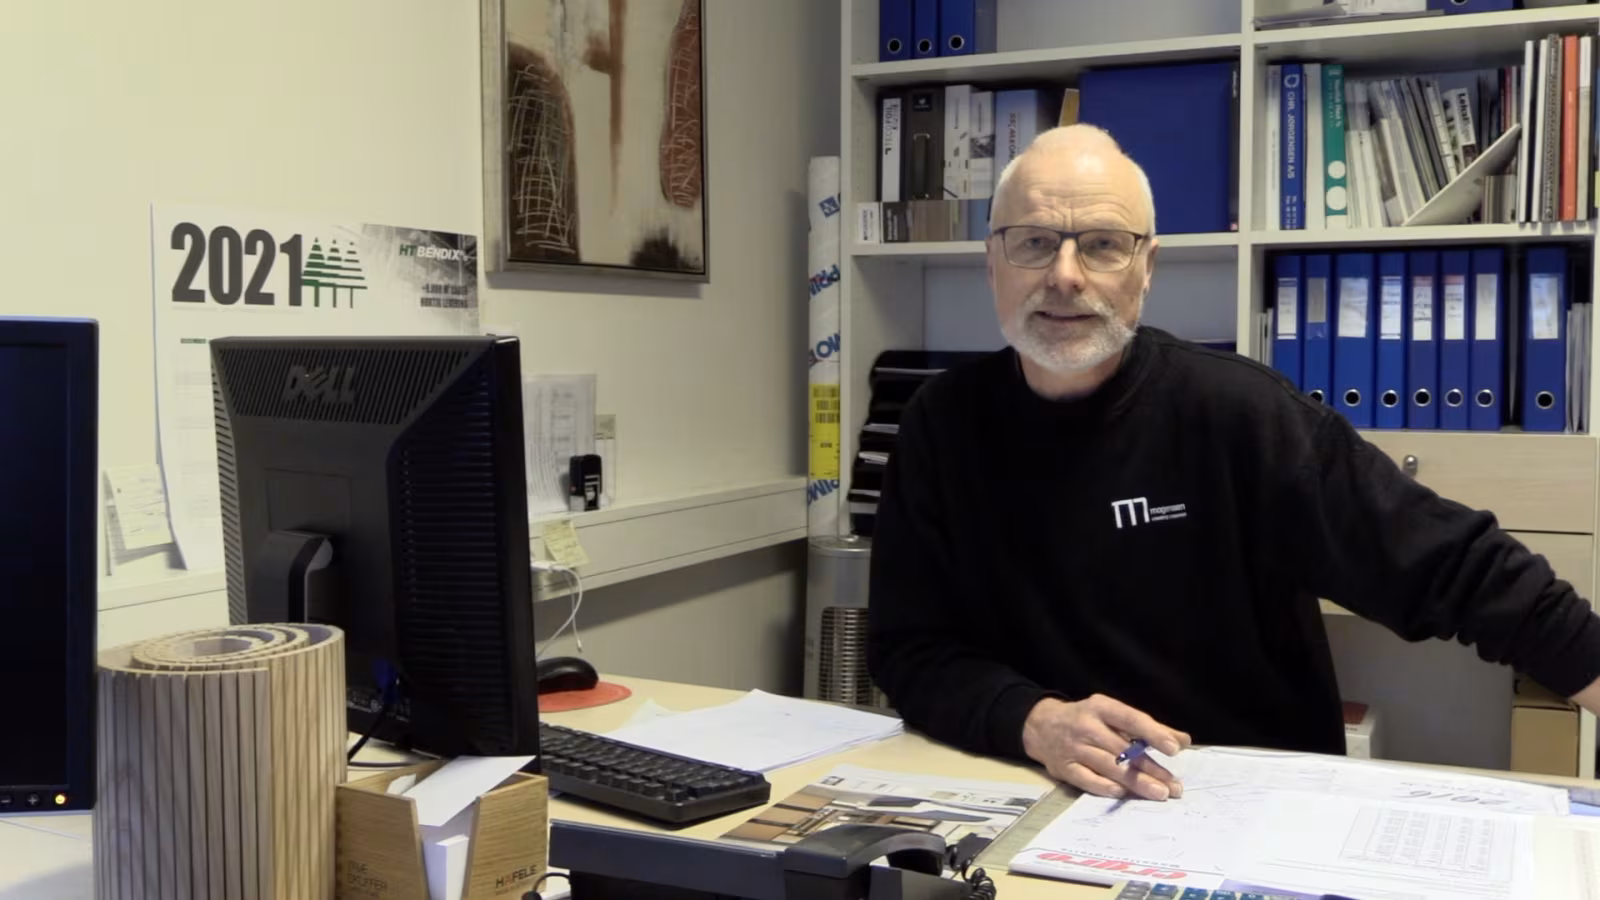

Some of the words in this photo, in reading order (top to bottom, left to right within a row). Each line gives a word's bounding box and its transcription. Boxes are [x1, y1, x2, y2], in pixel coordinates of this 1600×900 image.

[171, 222, 303, 307] 2021
[416, 245, 460, 261] BENDIX
[284, 366, 356, 403] DELL
